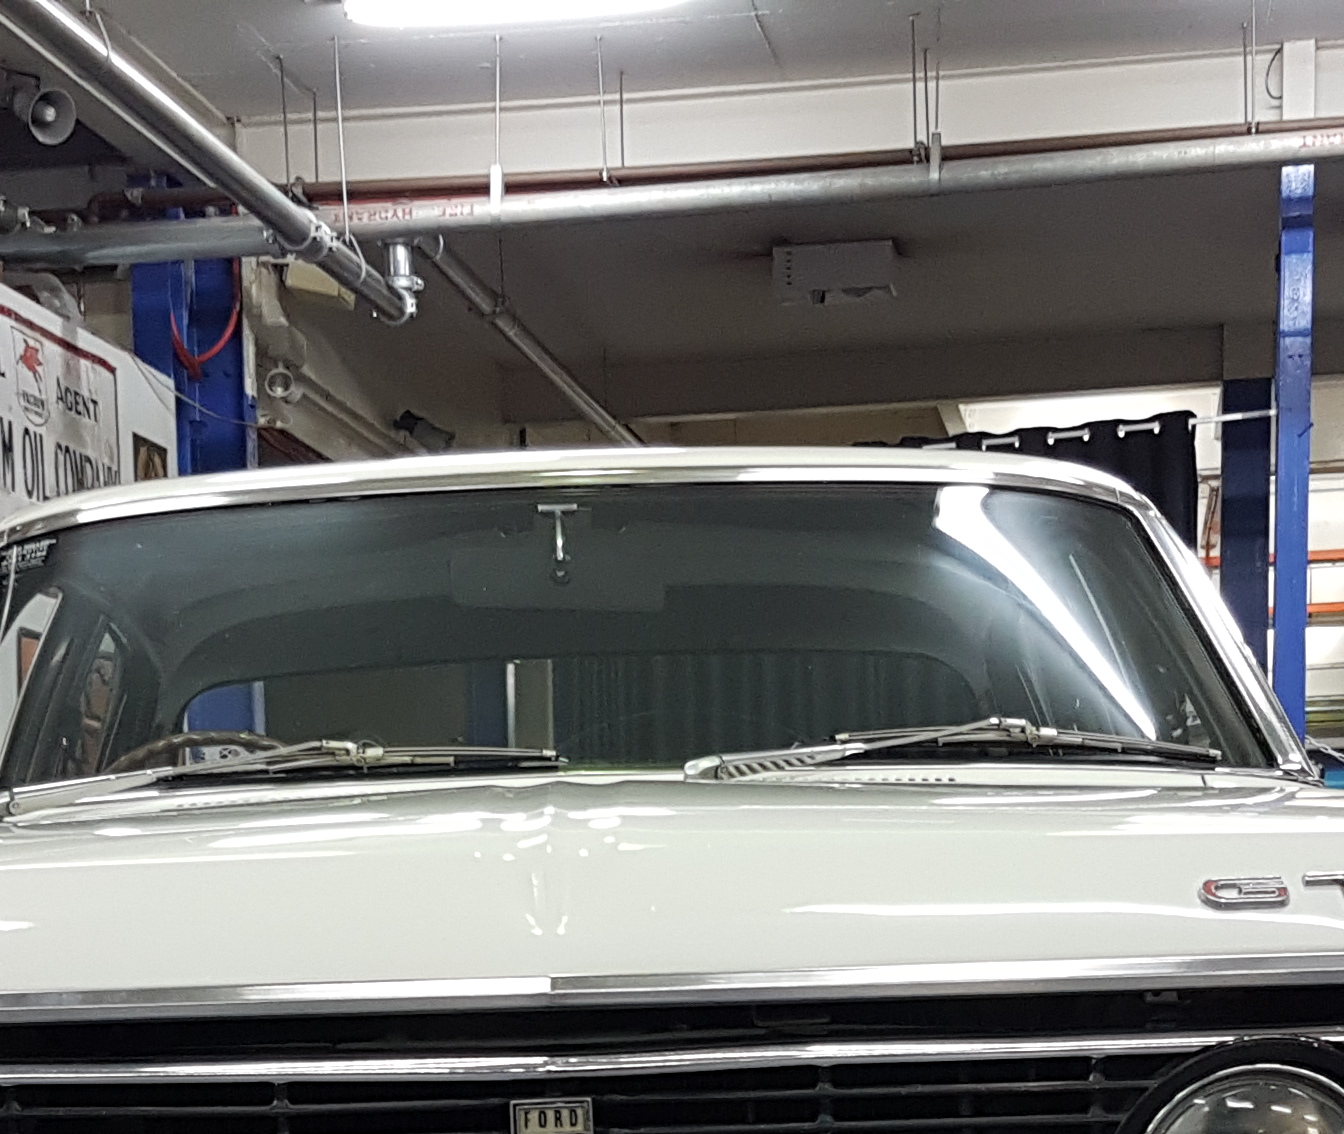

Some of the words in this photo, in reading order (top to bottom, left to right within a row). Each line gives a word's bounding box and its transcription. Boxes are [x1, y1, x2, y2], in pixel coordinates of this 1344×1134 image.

[56, 376, 99, 422] AGENT
[23, 427, 50, 500] OIL
[523, 1109, 579, 1130] FORD
